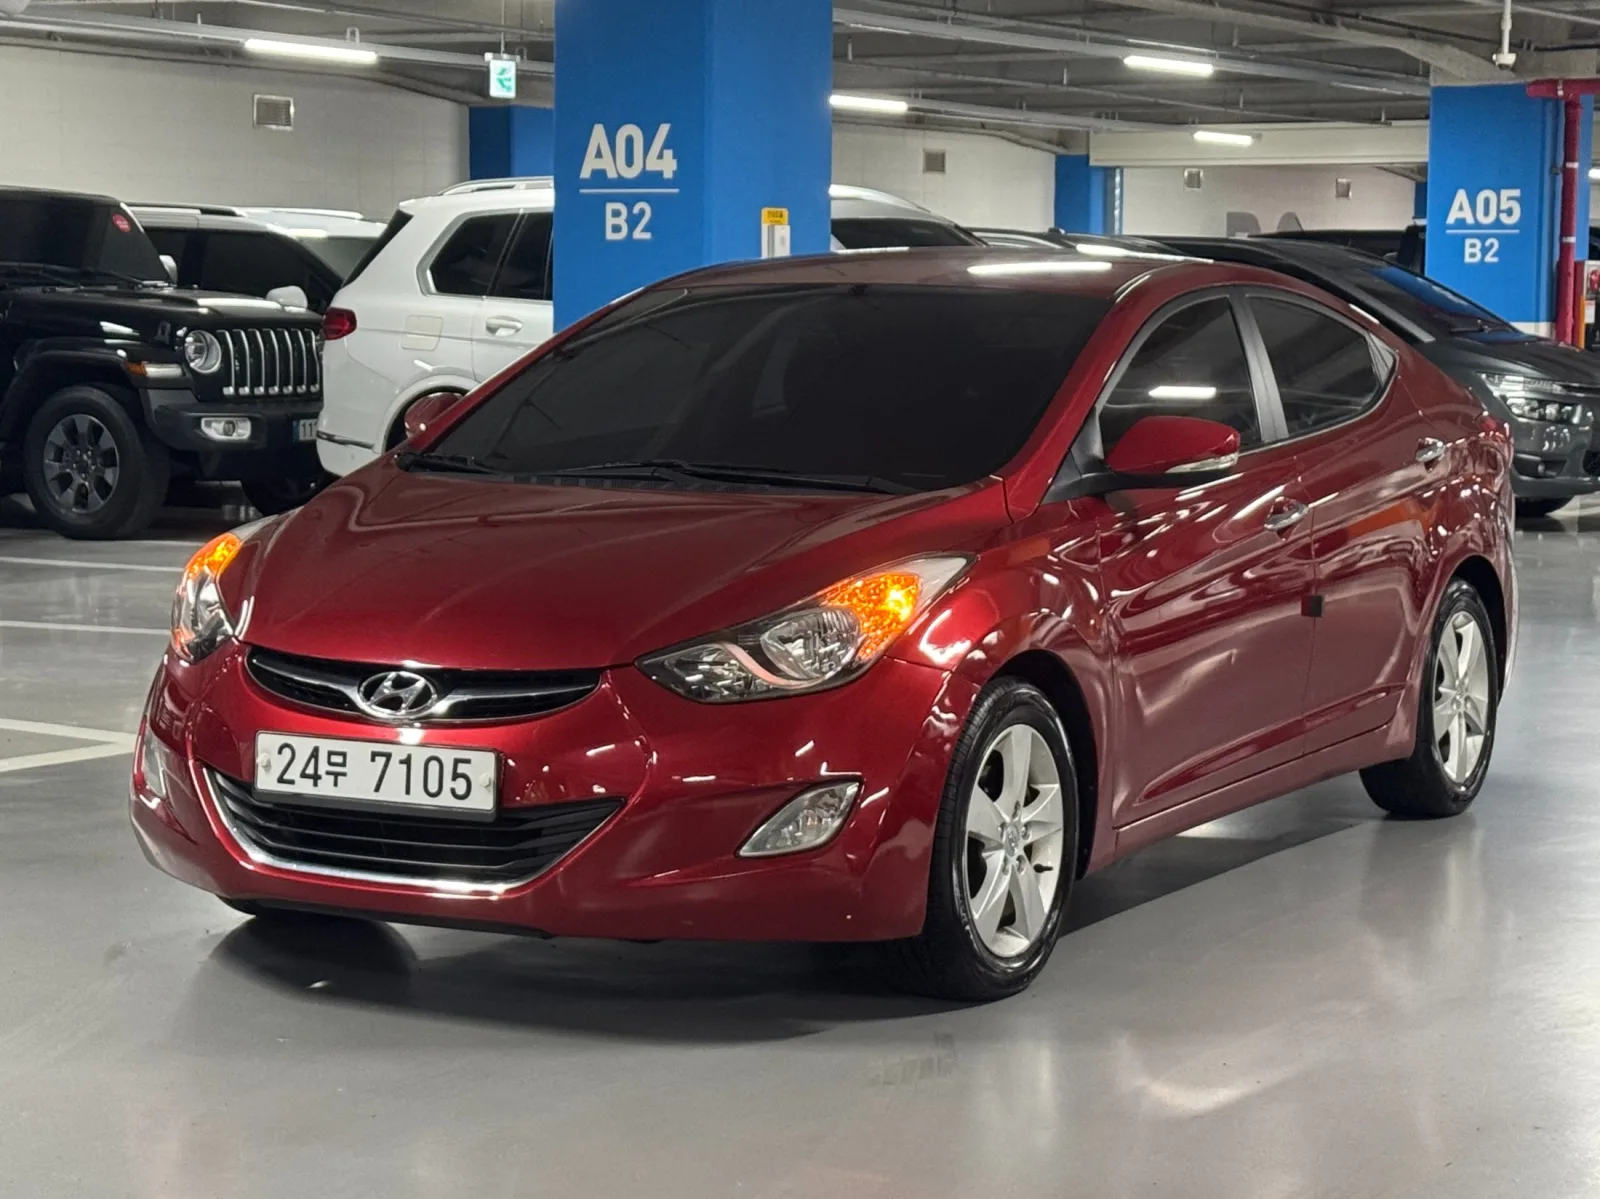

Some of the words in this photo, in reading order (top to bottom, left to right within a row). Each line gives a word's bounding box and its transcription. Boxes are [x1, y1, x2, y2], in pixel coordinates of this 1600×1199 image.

[580, 123, 678, 179] A04
[605, 201, 652, 240] B2
[1445, 188, 1521, 225] A05
[1464, 237, 1499, 263] B2
[276, 742, 348, 787] 24무
[370, 750, 472, 800] 7105
